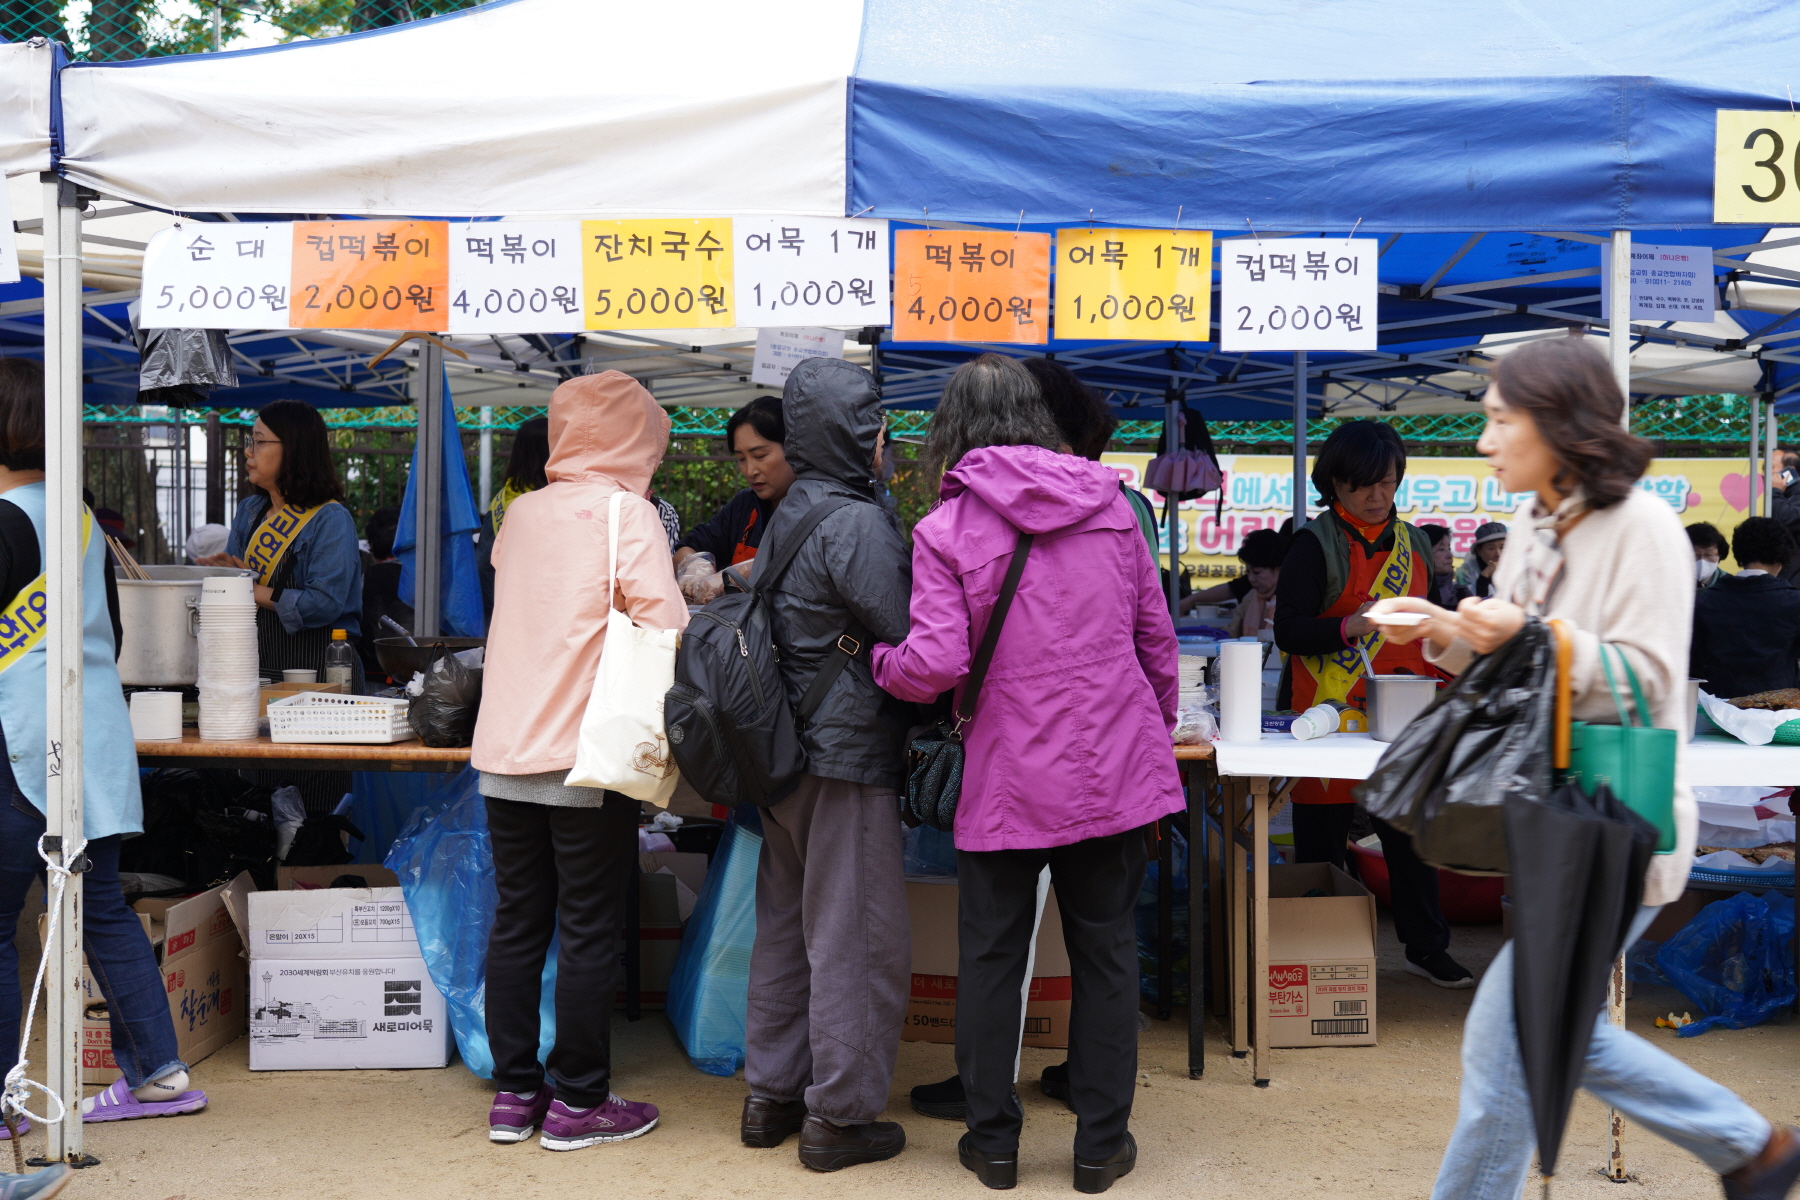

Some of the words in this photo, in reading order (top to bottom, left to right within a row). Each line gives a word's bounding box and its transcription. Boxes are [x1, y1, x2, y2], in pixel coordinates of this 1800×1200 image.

[1741, 128, 1800, 203] 3
[186, 234, 215, 261] 순
[236, 239, 265, 258] 대
[306, 232, 430, 262] 컵떡볶이
[466, 233, 556, 265] 떡볶이
[594, 229, 724, 263] 잔치국수
[745, 226, 805, 257] 어묵
[1068, 239, 1129, 271] 어묵
[924, 242, 1015, 273] 떡볶이
[1236, 250, 1359, 282] 컵떡볶이
[156, 283, 288, 313] 5,000원
[304, 283, 435, 314] 2,000원
[452, 285, 580, 318] 4,000원
[594, 284, 728, 319] 5,000원
[753, 277, 877, 310] 1,000원
[1073, 293, 1196, 324] 1,000원
[907, 295, 1034, 326] 4,000원
[1236, 302, 1364, 335] 2,000원
[362, 967, 396, 976] 응원합니다!
[1268, 990, 1304, 1005] 부탄가스
[372, 1018, 434, 1034] 새로미어묵
